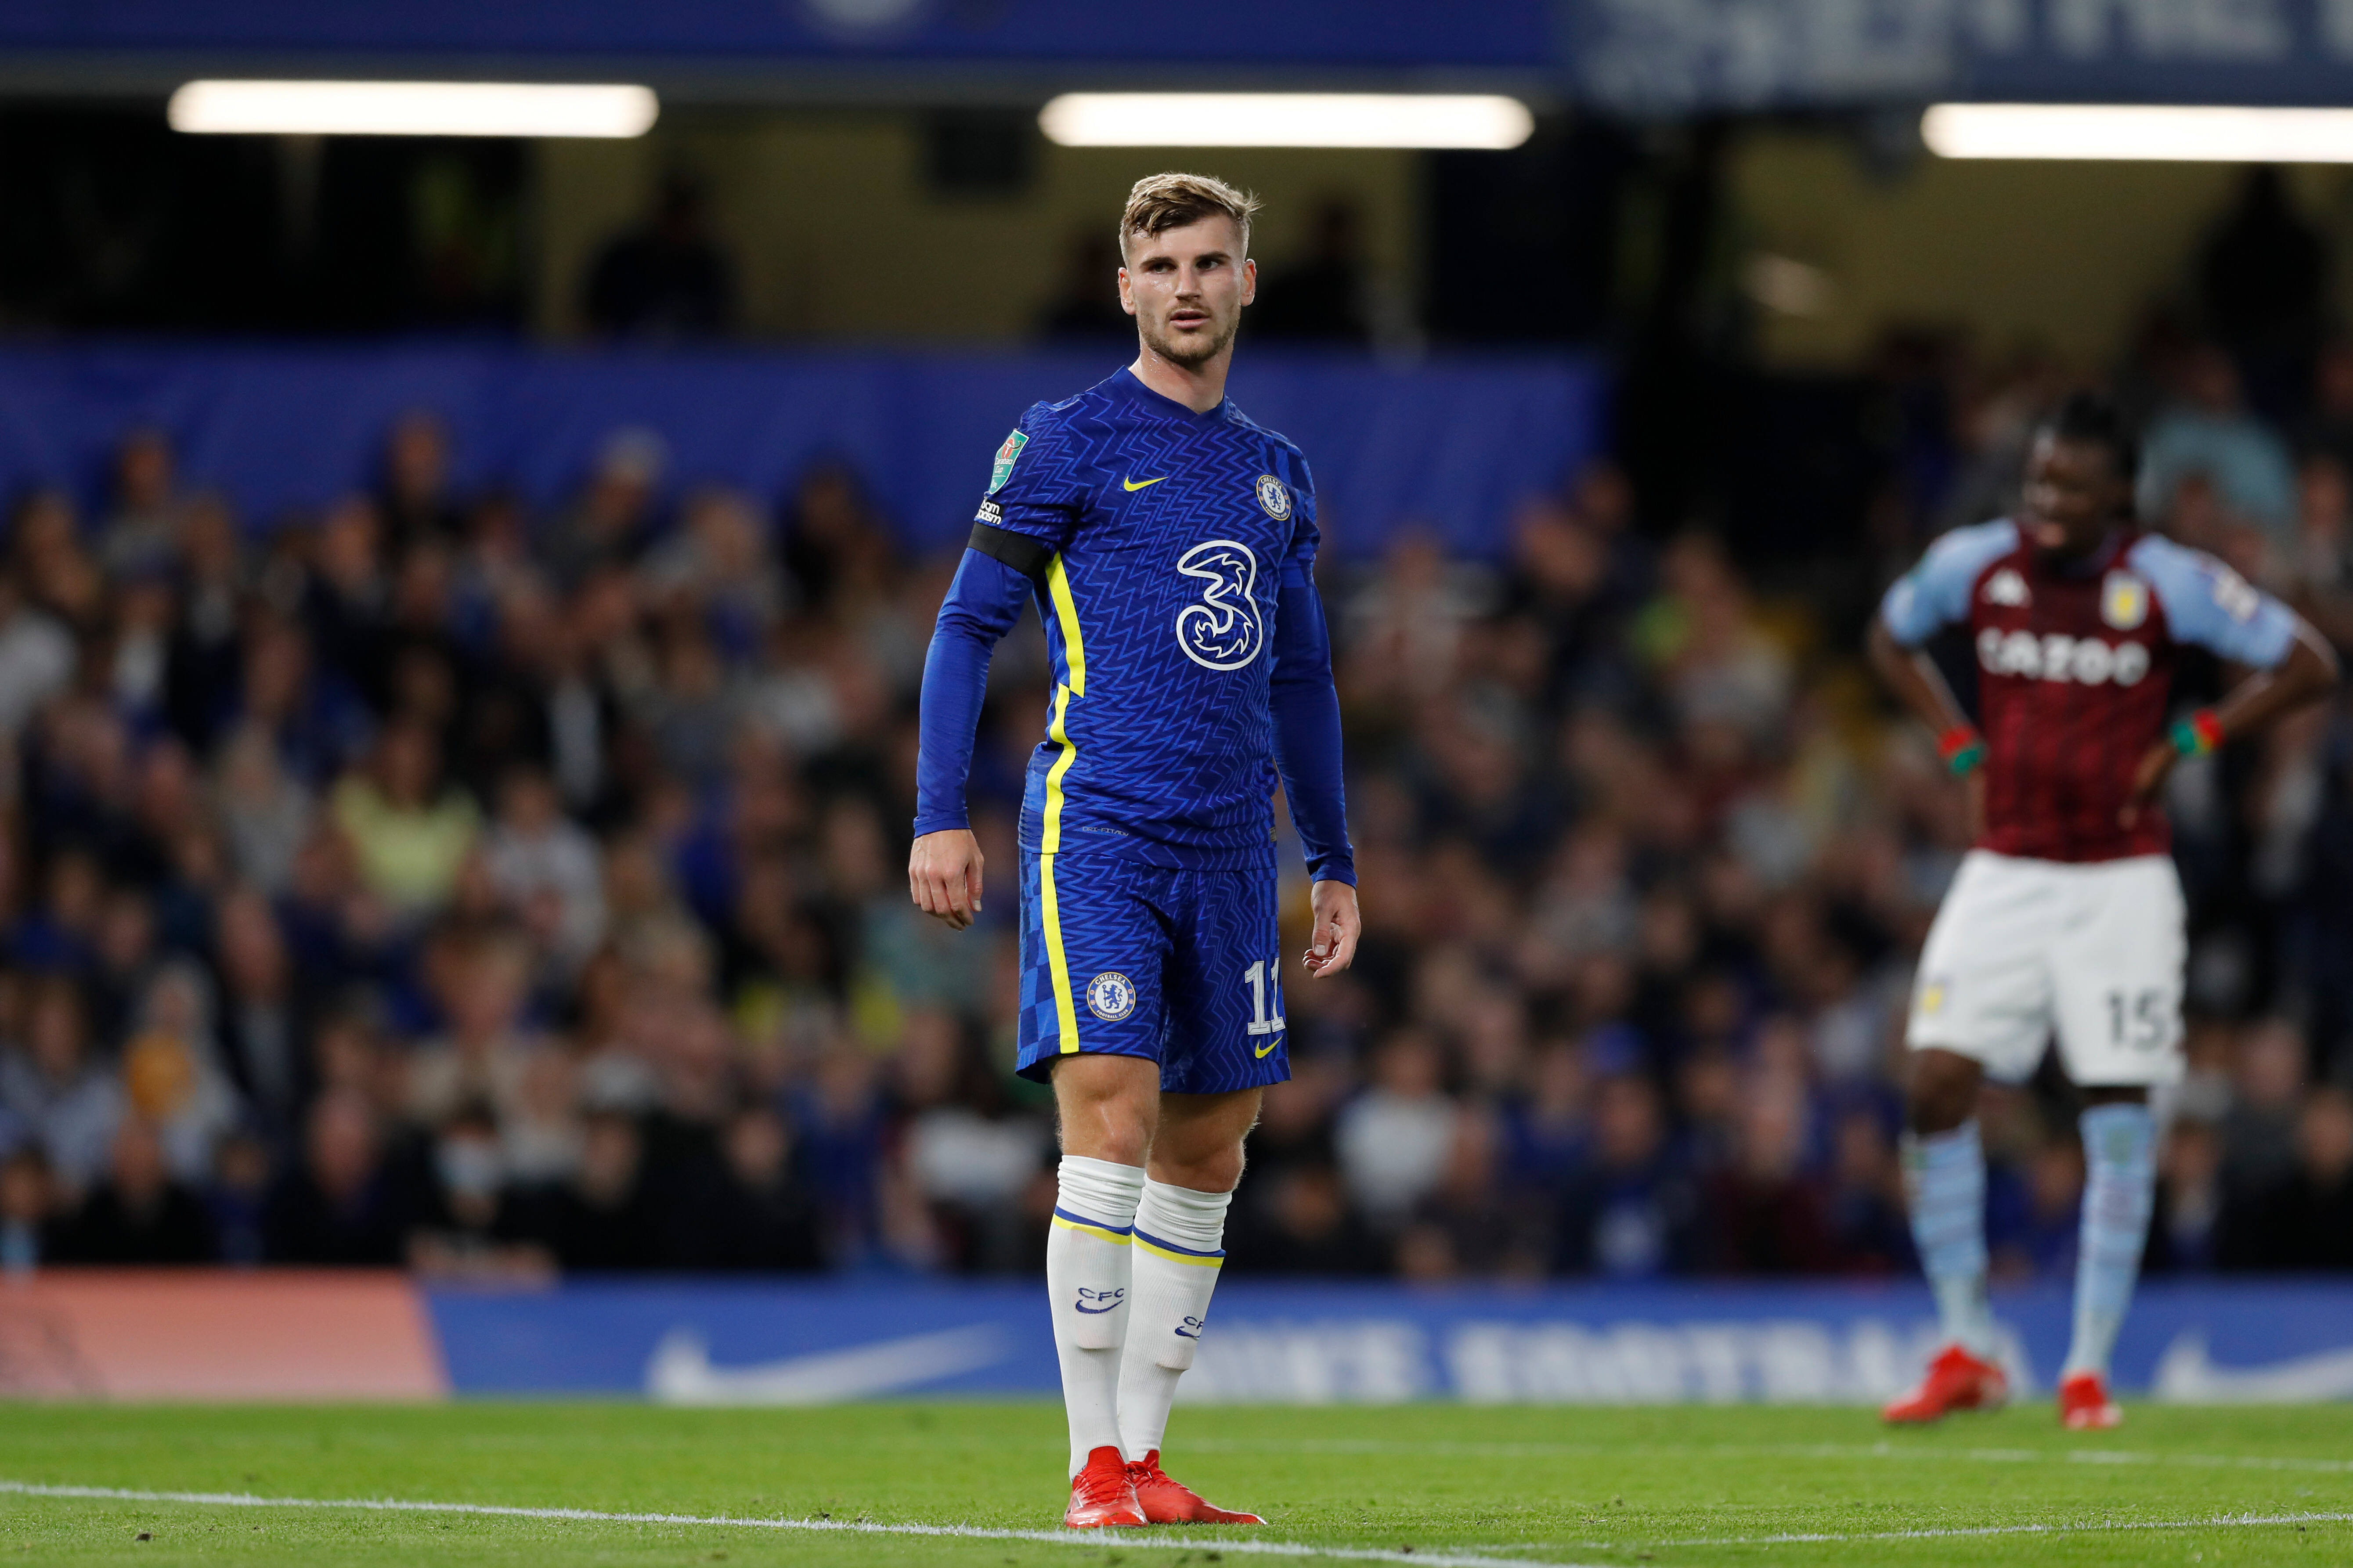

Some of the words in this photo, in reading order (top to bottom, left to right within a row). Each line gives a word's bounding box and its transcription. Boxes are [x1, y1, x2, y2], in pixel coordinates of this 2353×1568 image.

[1260, 477, 1282, 490] CHELSEA
[1176, 540, 1263, 670] 3
[1095, 974, 1126, 985] CHELSEA
[1245, 957, 1286, 1035] 11
[1096, 1010, 1118, 1018] FOOTBALL
[2108, 987, 2167, 1053] 15
[1078, 1287, 1124, 1301] CFC
[1184, 1316, 1204, 1329] CF
